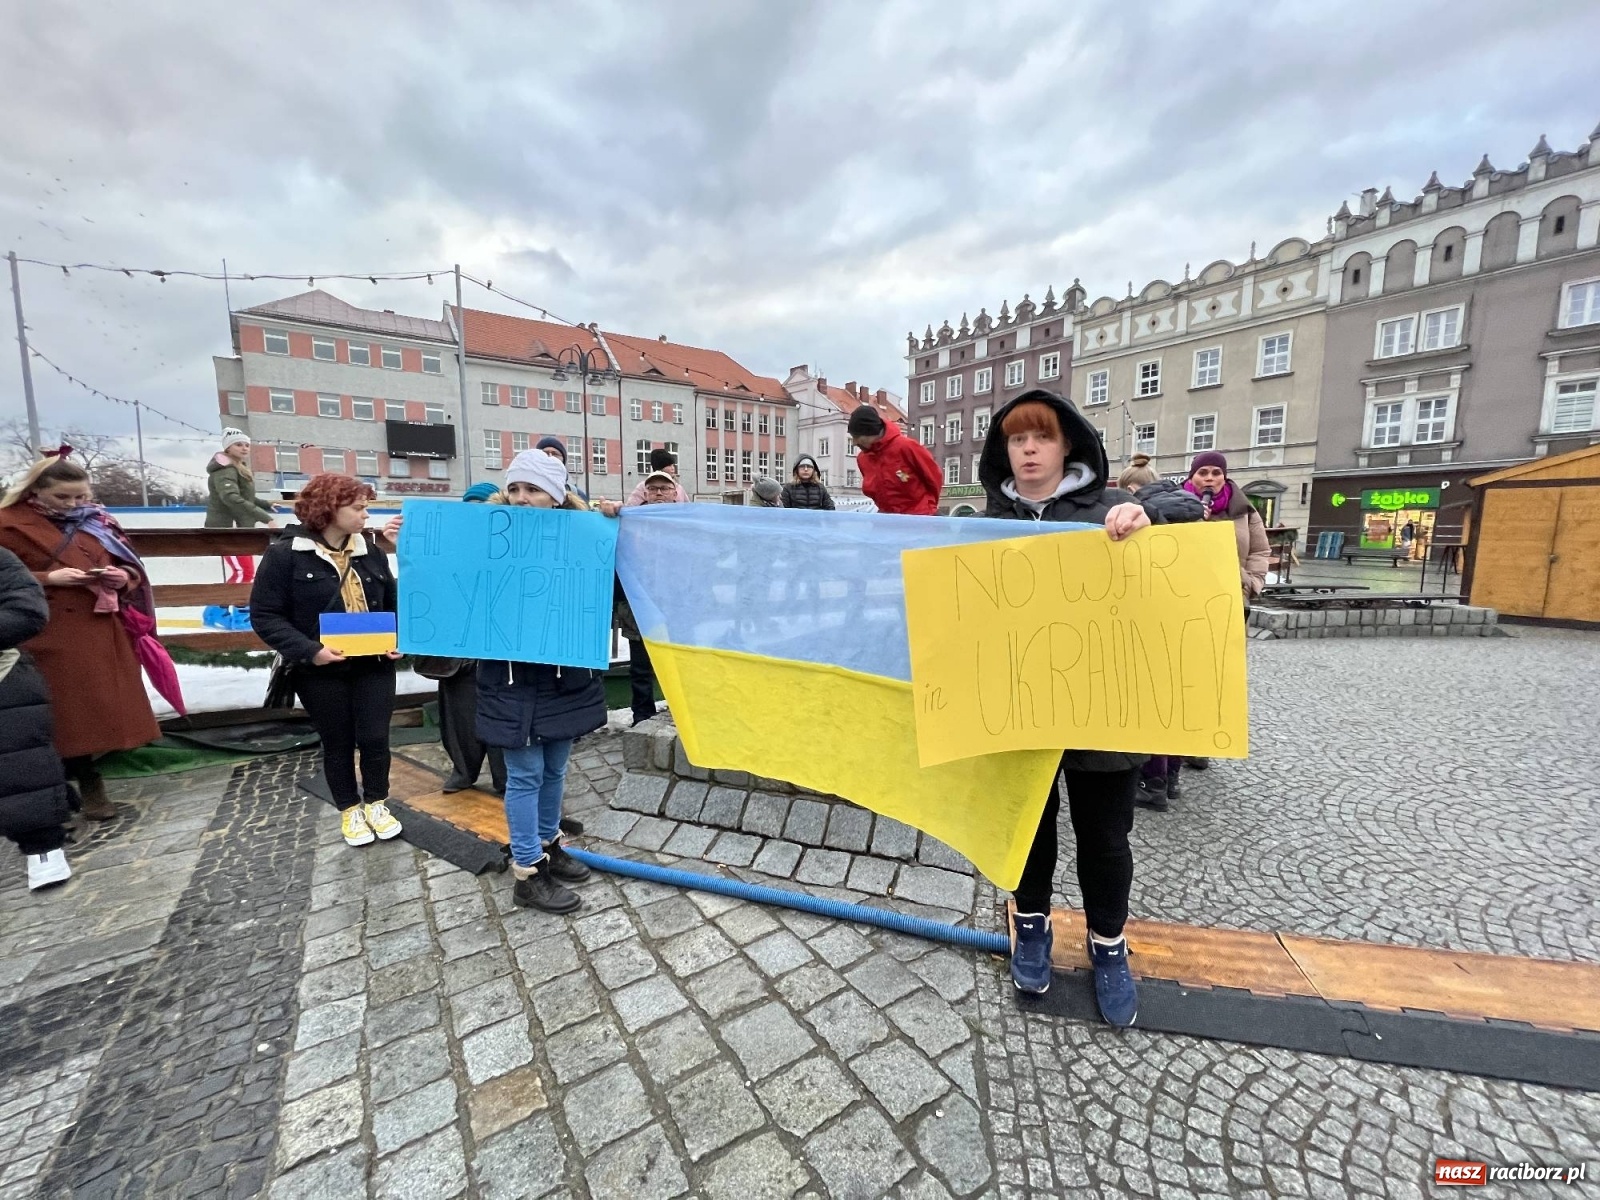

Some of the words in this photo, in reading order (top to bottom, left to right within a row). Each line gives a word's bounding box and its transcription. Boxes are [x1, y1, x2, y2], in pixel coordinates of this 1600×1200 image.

[1370, 491, 1430, 507] żabka
[405, 505, 441, 556] НІ
[955, 548, 1035, 621] NO
[1058, 534, 1190, 603] WAR
[408, 591, 436, 644] В
[924, 682, 948, 714] in
